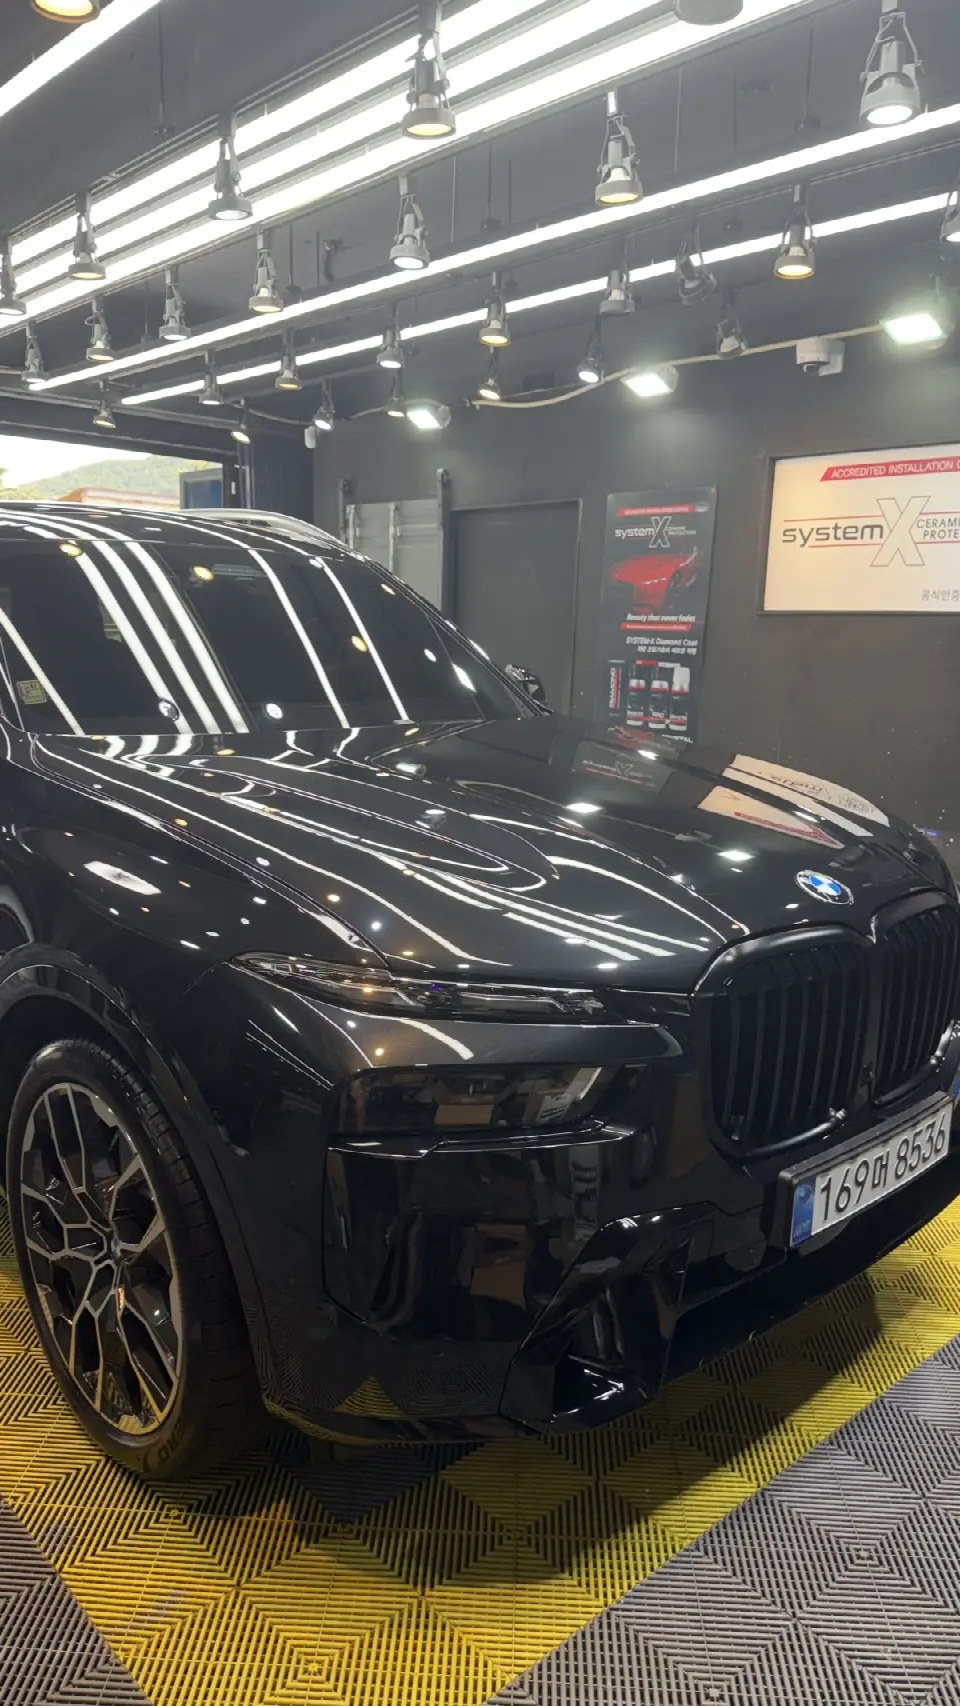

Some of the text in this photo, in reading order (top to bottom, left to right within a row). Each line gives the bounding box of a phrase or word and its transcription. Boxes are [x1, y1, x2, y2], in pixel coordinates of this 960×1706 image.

[831, 467, 885, 479] ACCREDITED
[888, 460, 954, 474] INSTALLATION
[614, 527, 654, 540] system
[782, 523, 883, 547] system
[626, 613, 647, 623] Beauty
[647, 613, 660, 621] that
[678, 614, 696, 622] fades
[625, 636, 698, 647] SYSTEM-X Diamond Coat
[894, 1112, 946, 1180] 8536
